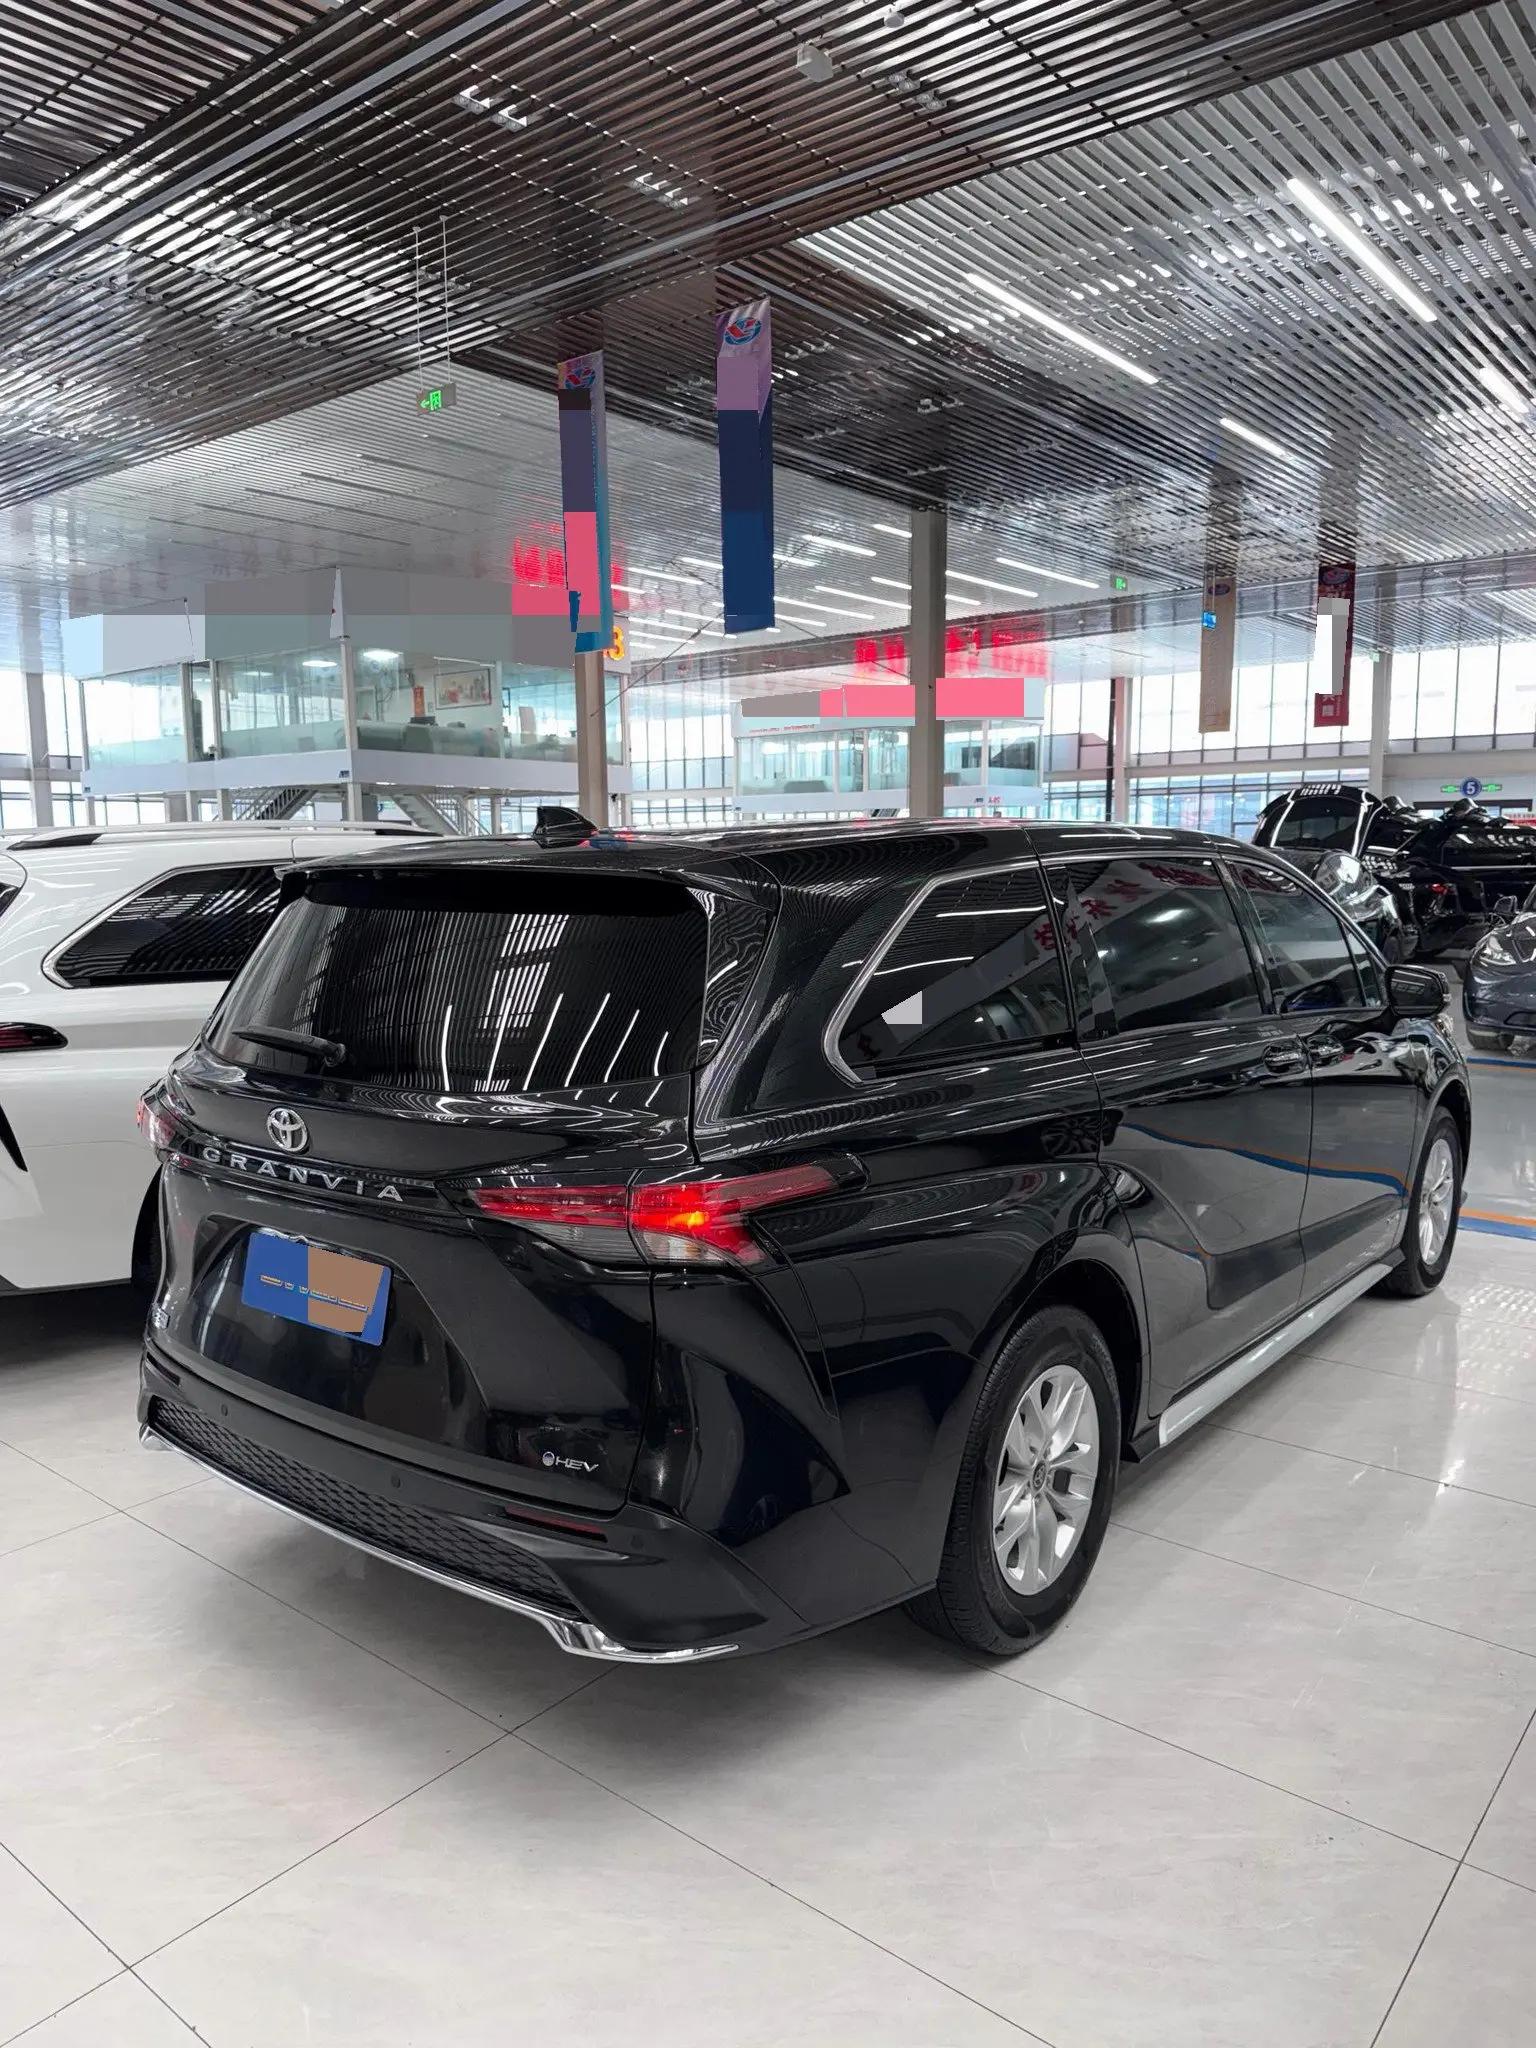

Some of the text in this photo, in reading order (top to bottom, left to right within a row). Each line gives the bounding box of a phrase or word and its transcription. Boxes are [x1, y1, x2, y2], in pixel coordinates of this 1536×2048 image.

[1466, 781, 1476, 795] 5
[202, 1147, 403, 1202] GRANVIA
[555, 1456, 599, 1472] HEV
